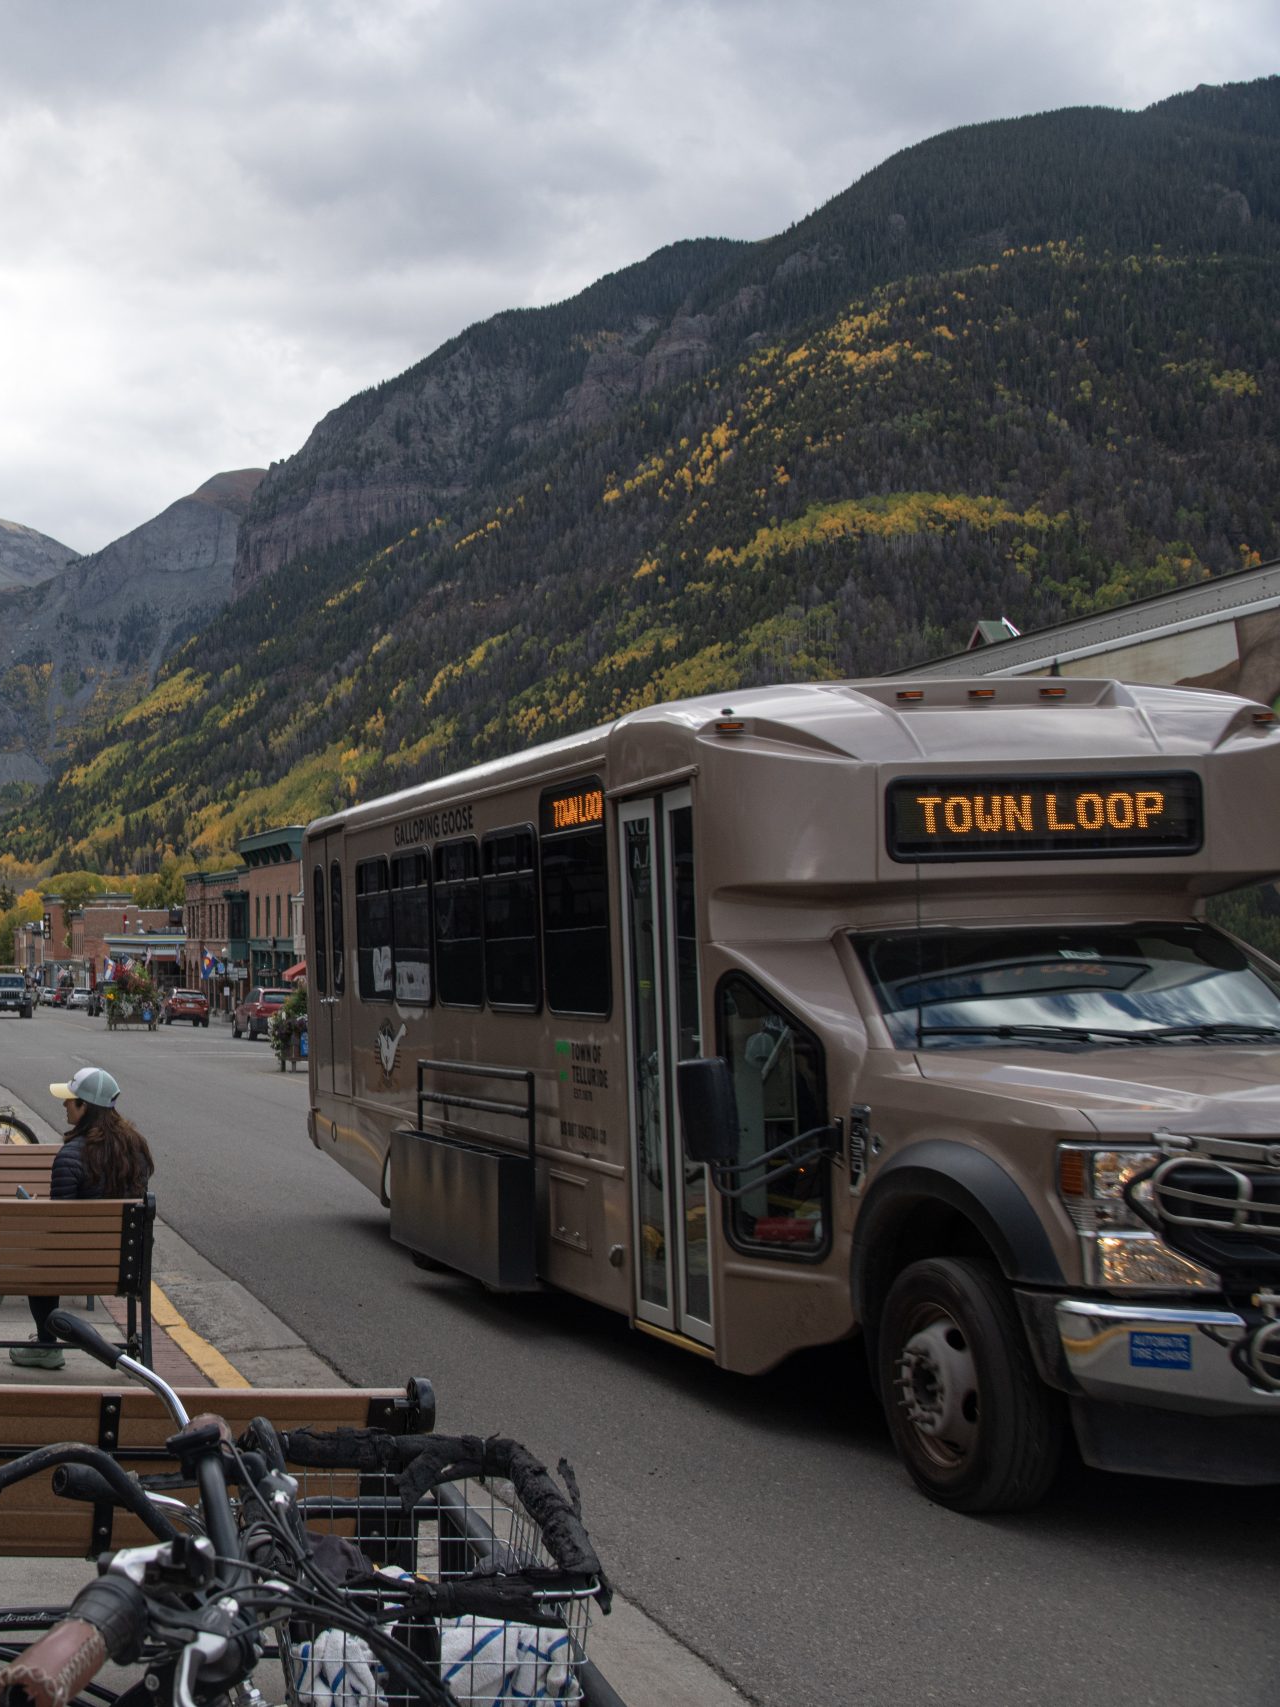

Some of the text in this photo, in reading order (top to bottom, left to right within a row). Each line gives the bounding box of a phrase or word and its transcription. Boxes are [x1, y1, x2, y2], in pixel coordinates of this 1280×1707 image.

[553, 795, 578, 828] TOWN
[916, 791, 1165, 833] TOWN LOOP
[394, 805, 474, 846] GALLOPING GOOSE
[571, 1042, 602, 1064] TOWN OF
[571, 1065, 608, 1089] TELLURIDE
[1132, 1334, 1188, 1349] AUTOMATIC
[1131, 1347, 1191, 1362] TIRE CHAINS
